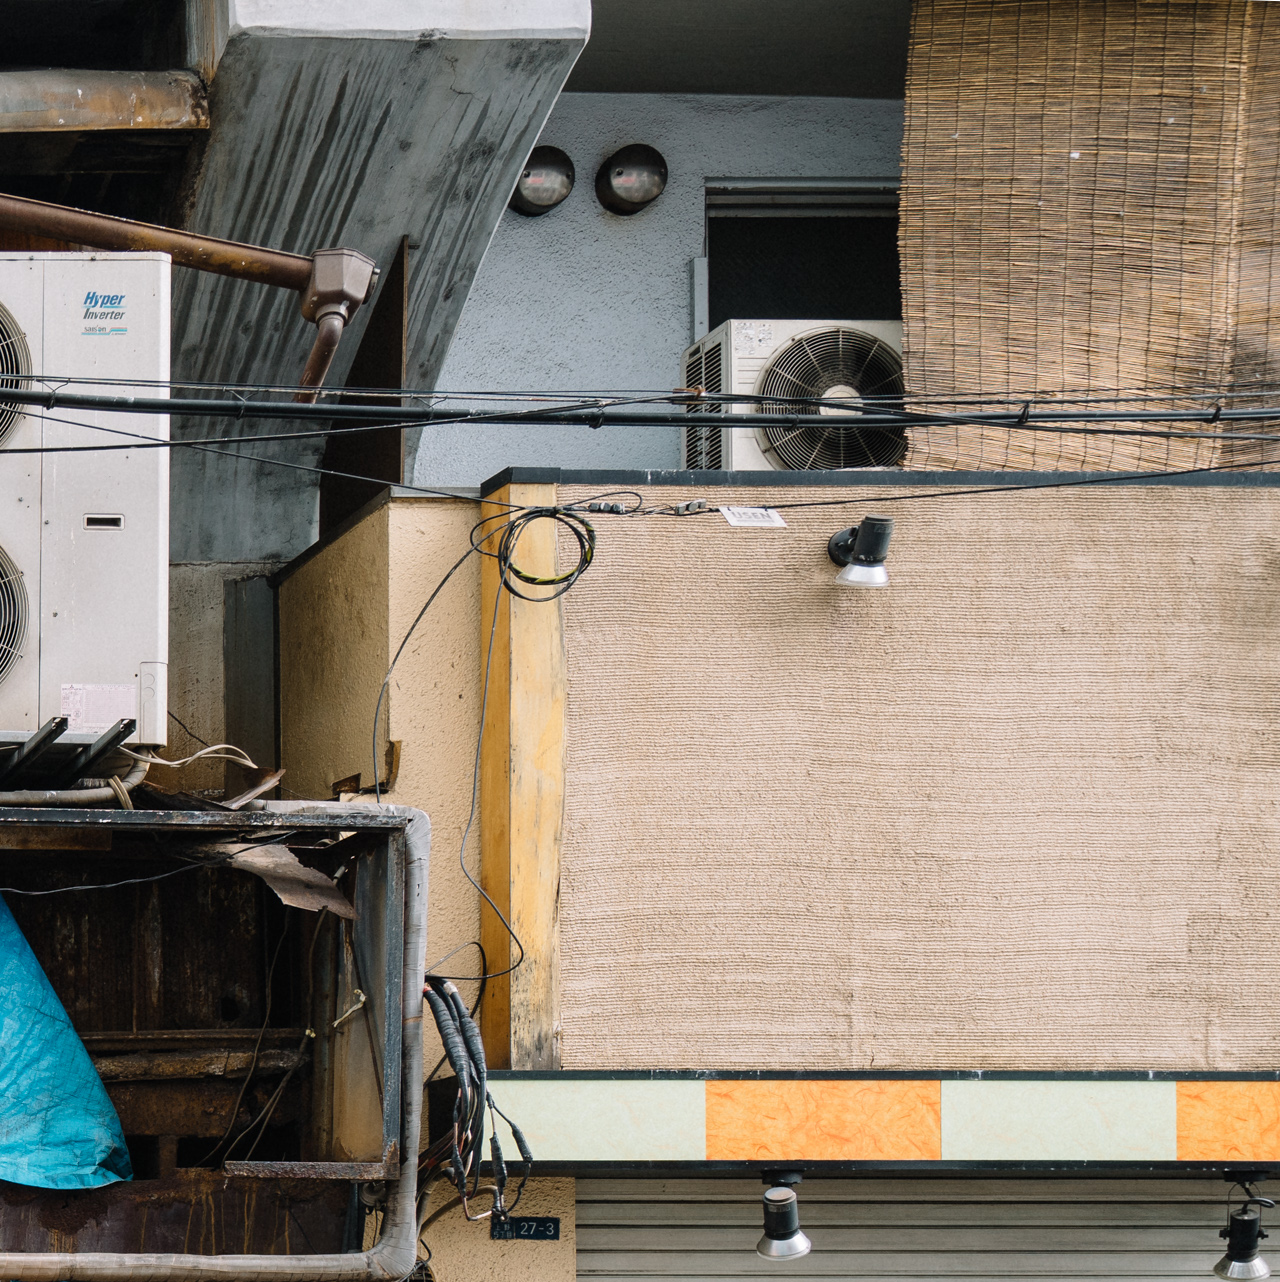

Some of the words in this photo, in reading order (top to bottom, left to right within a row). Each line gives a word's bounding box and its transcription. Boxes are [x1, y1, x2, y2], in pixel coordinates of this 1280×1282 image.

[83, 291, 126, 308] Hyper
[82, 308, 126, 320] Inverter
[520, 1222, 554, 1236] 27-3
